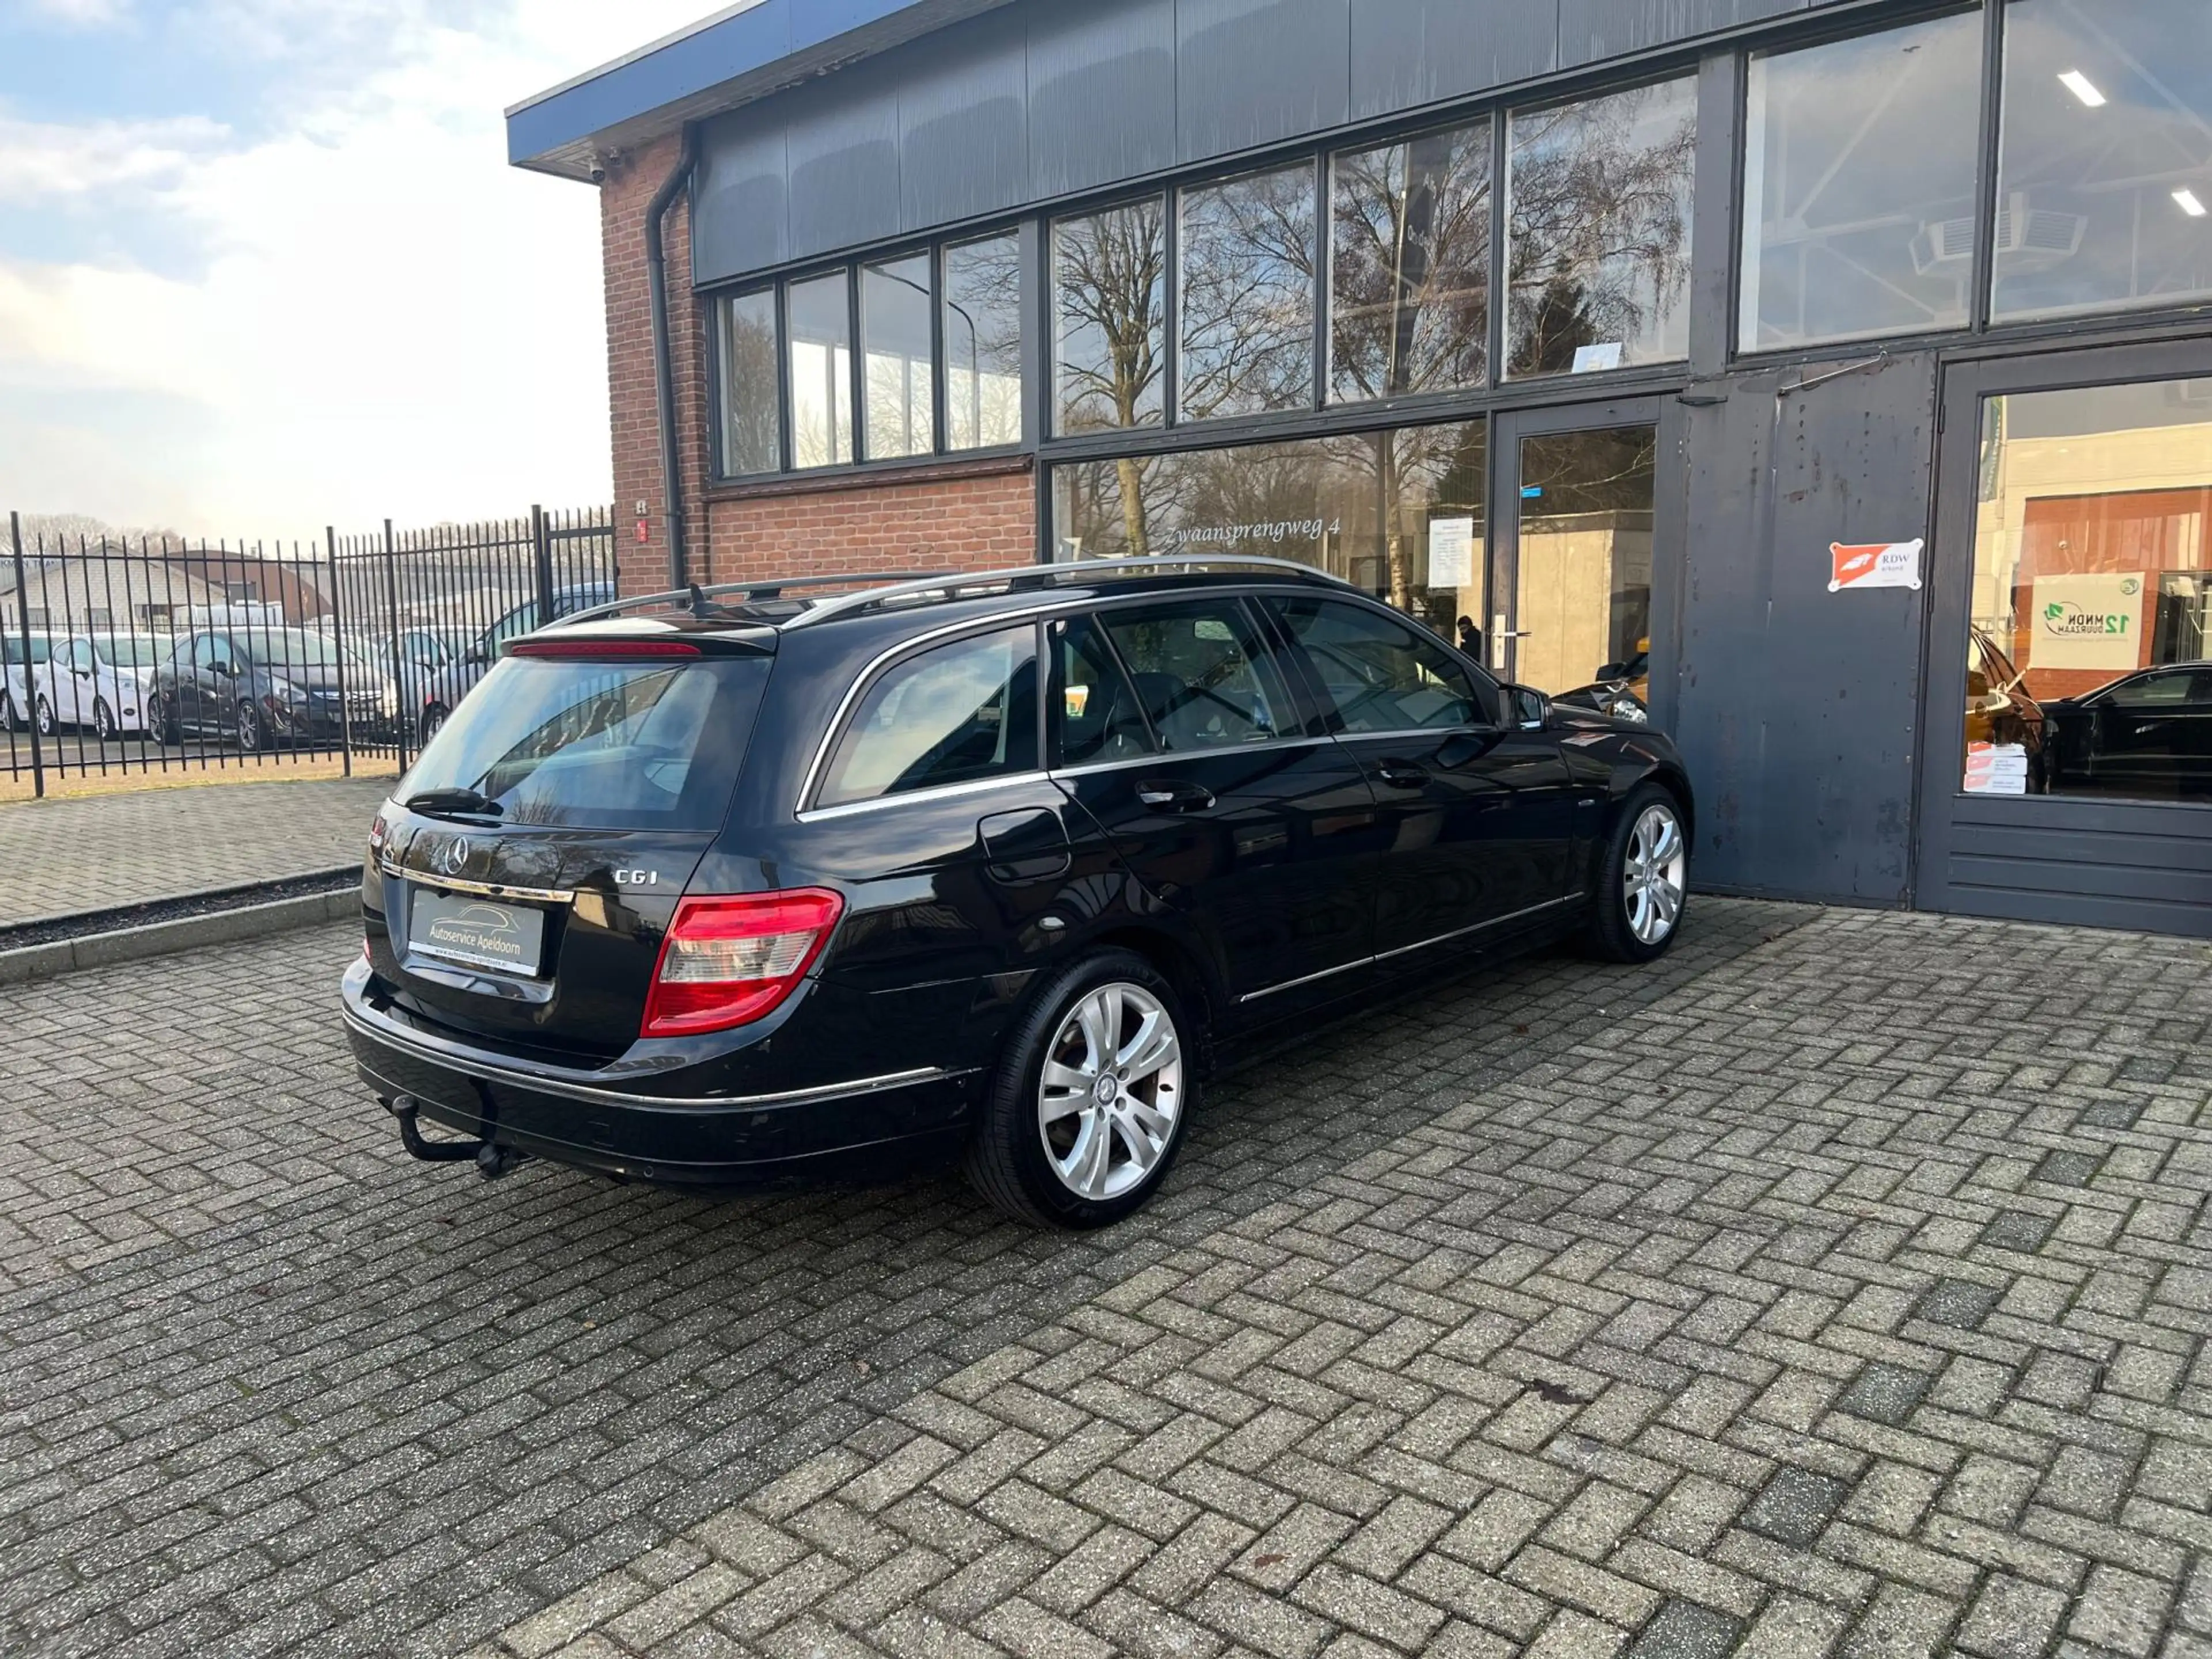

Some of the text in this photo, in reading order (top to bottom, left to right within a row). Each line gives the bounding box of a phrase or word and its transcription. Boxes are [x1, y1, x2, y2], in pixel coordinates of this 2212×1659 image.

[1165, 516, 1341, 546] Zwaansprengweg 4
[1883, 554, 1910, 563] RDW
[615, 869, 657, 885] CGI
[429, 926, 521, 955] Autoservice Apeldoorn
